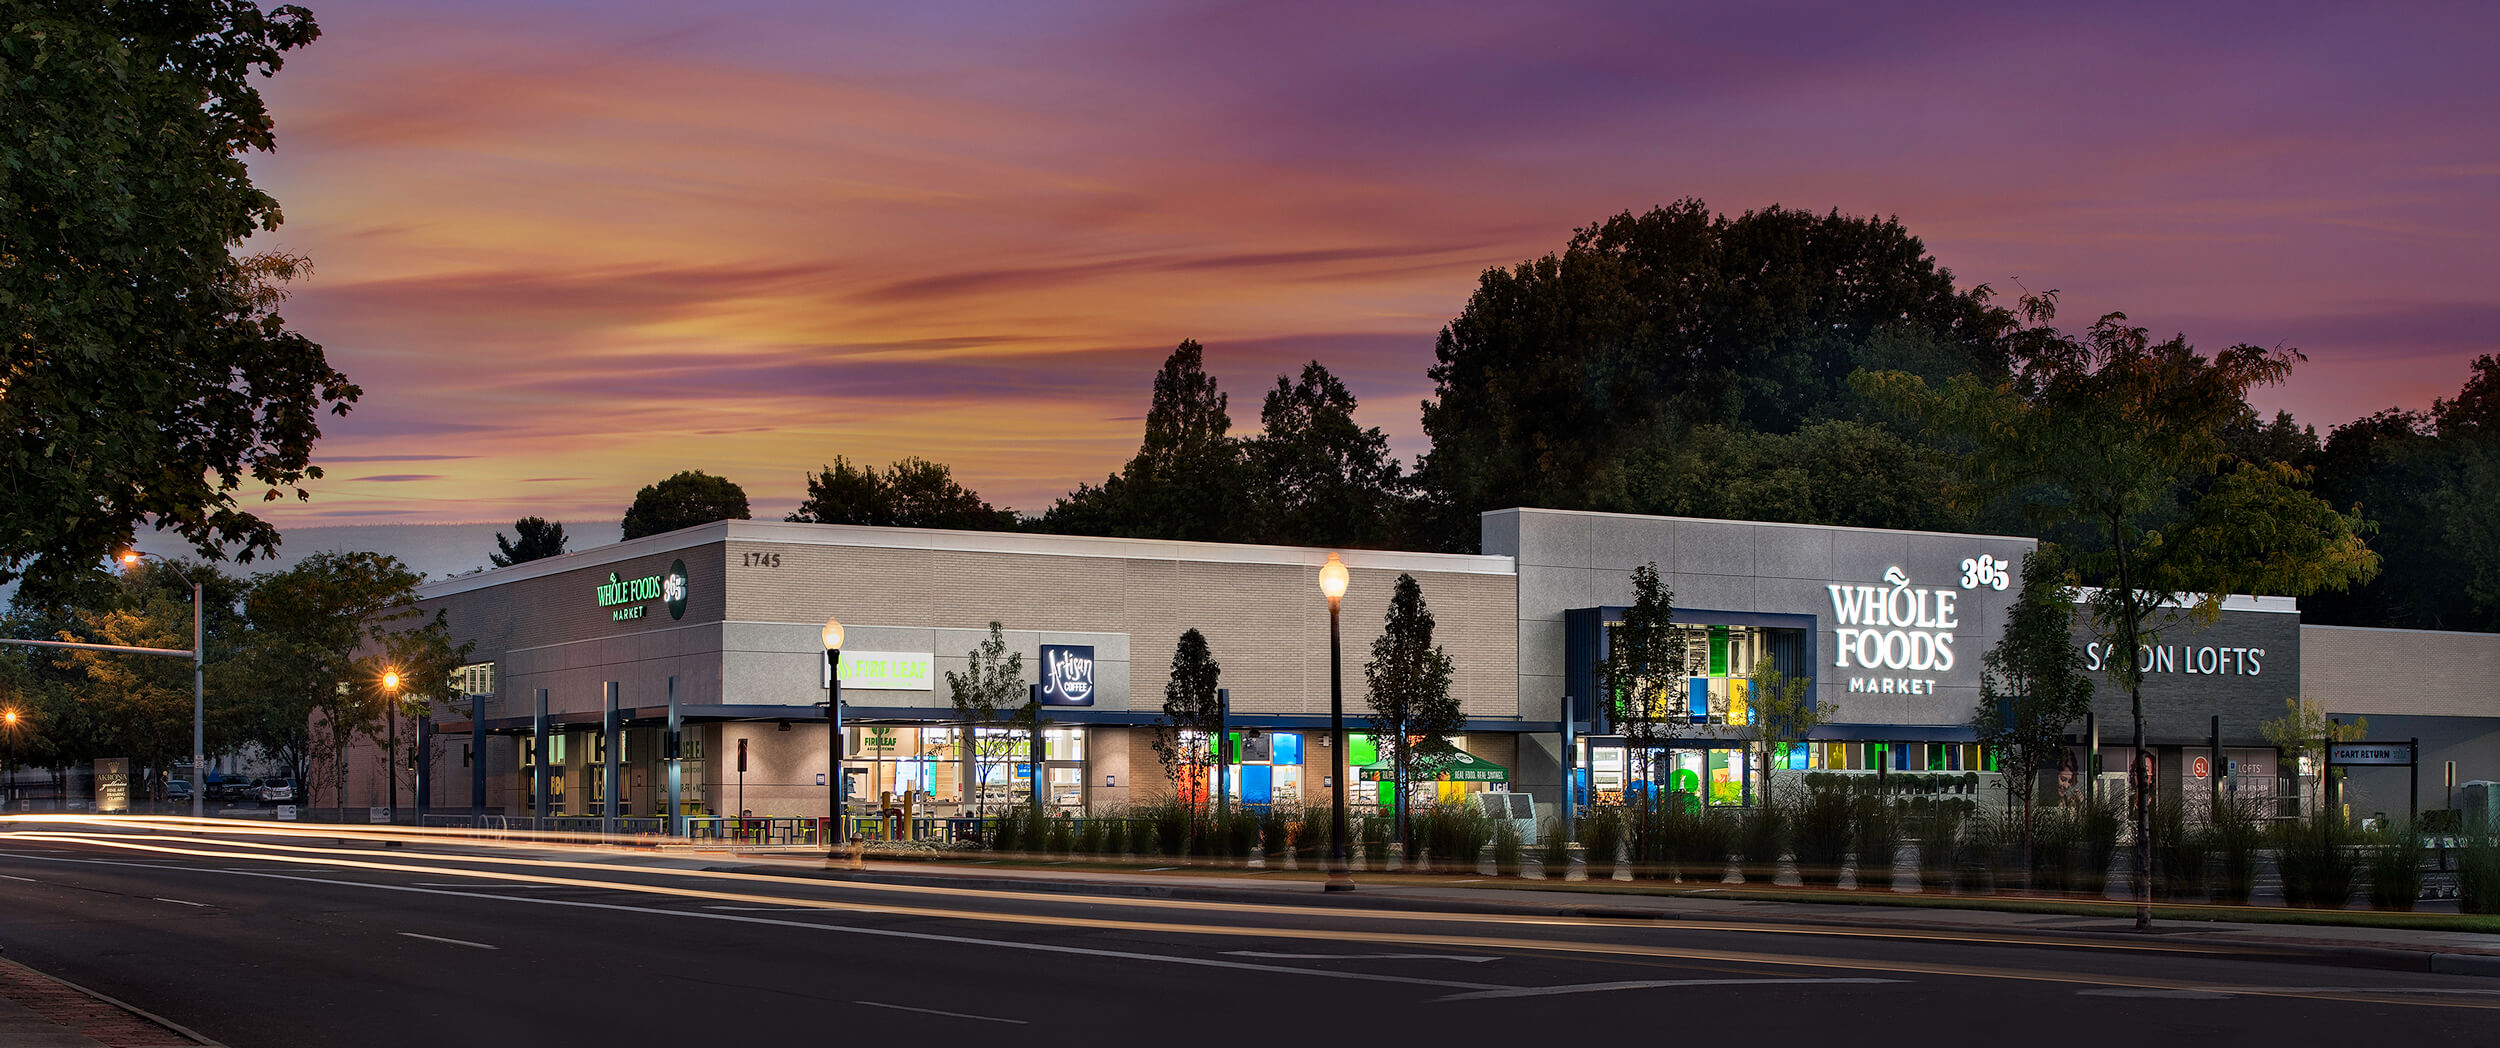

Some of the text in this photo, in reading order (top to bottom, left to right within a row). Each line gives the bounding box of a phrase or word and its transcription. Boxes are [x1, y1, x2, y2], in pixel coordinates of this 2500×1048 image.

[743, 553, 780, 567] 1745
[1961, 554, 2010, 591] 365
[597, 575, 661, 607] WHOLE FOODS
[663, 574, 683, 602] 365
[1827, 576, 1958, 628] WHOLE
[613, 606, 644, 621] MARKET
[1834, 628, 1954, 671] FOODS
[2085, 642, 2174, 673] SON
[856, 660, 927, 679] FIRE LEAF
[1063, 682, 1088, 692] COFFEE
[1850, 677, 1936, 694] MARKET
[2340, 750, 2359, 758] CART
[2360, 750, 2390, 759] RETURN
[2196, 763, 2207, 773] SL
